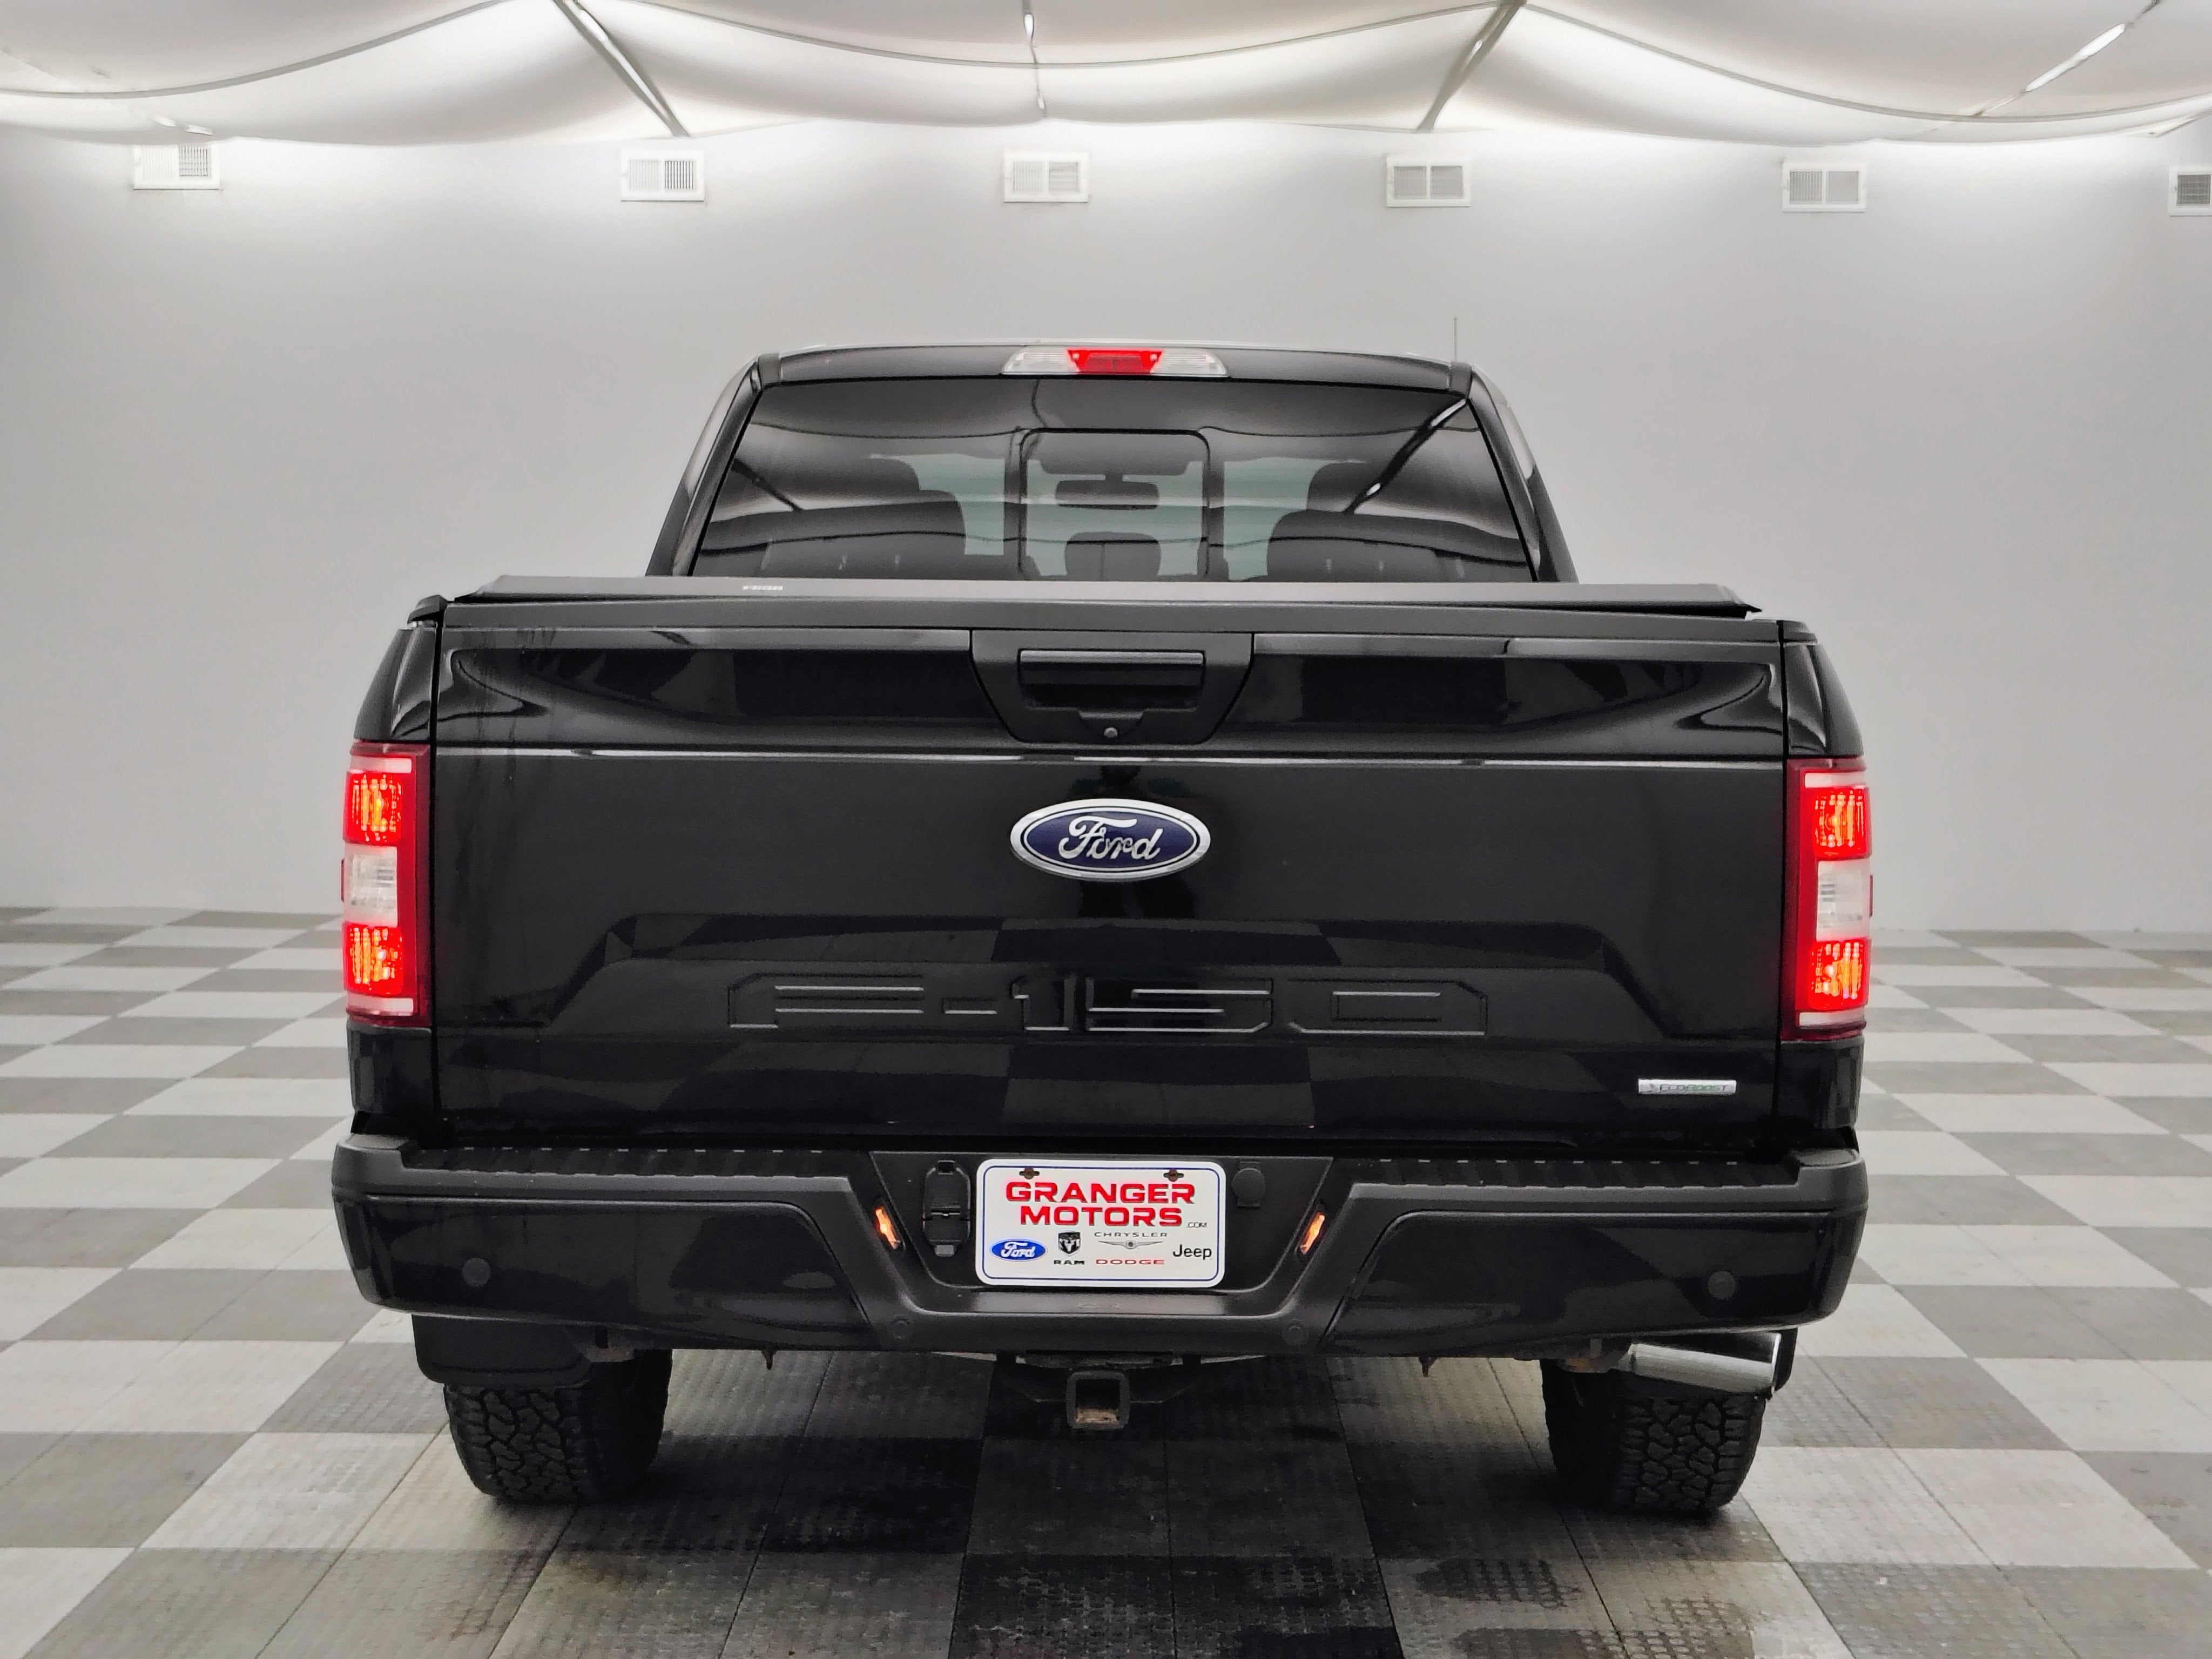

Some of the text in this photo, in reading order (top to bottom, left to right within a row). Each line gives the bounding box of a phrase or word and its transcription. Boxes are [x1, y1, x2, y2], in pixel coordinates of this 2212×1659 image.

[1058, 815, 1163, 860] Ford
[727, 973, 1488, 1036] F-150
[1005, 1181, 1195, 1204] GRANGER
[1020, 1205, 1182, 1227] MOTORS
[1000, 1242, 1035, 1258] Ford
[1172, 1244, 1212, 1260] Jeep
